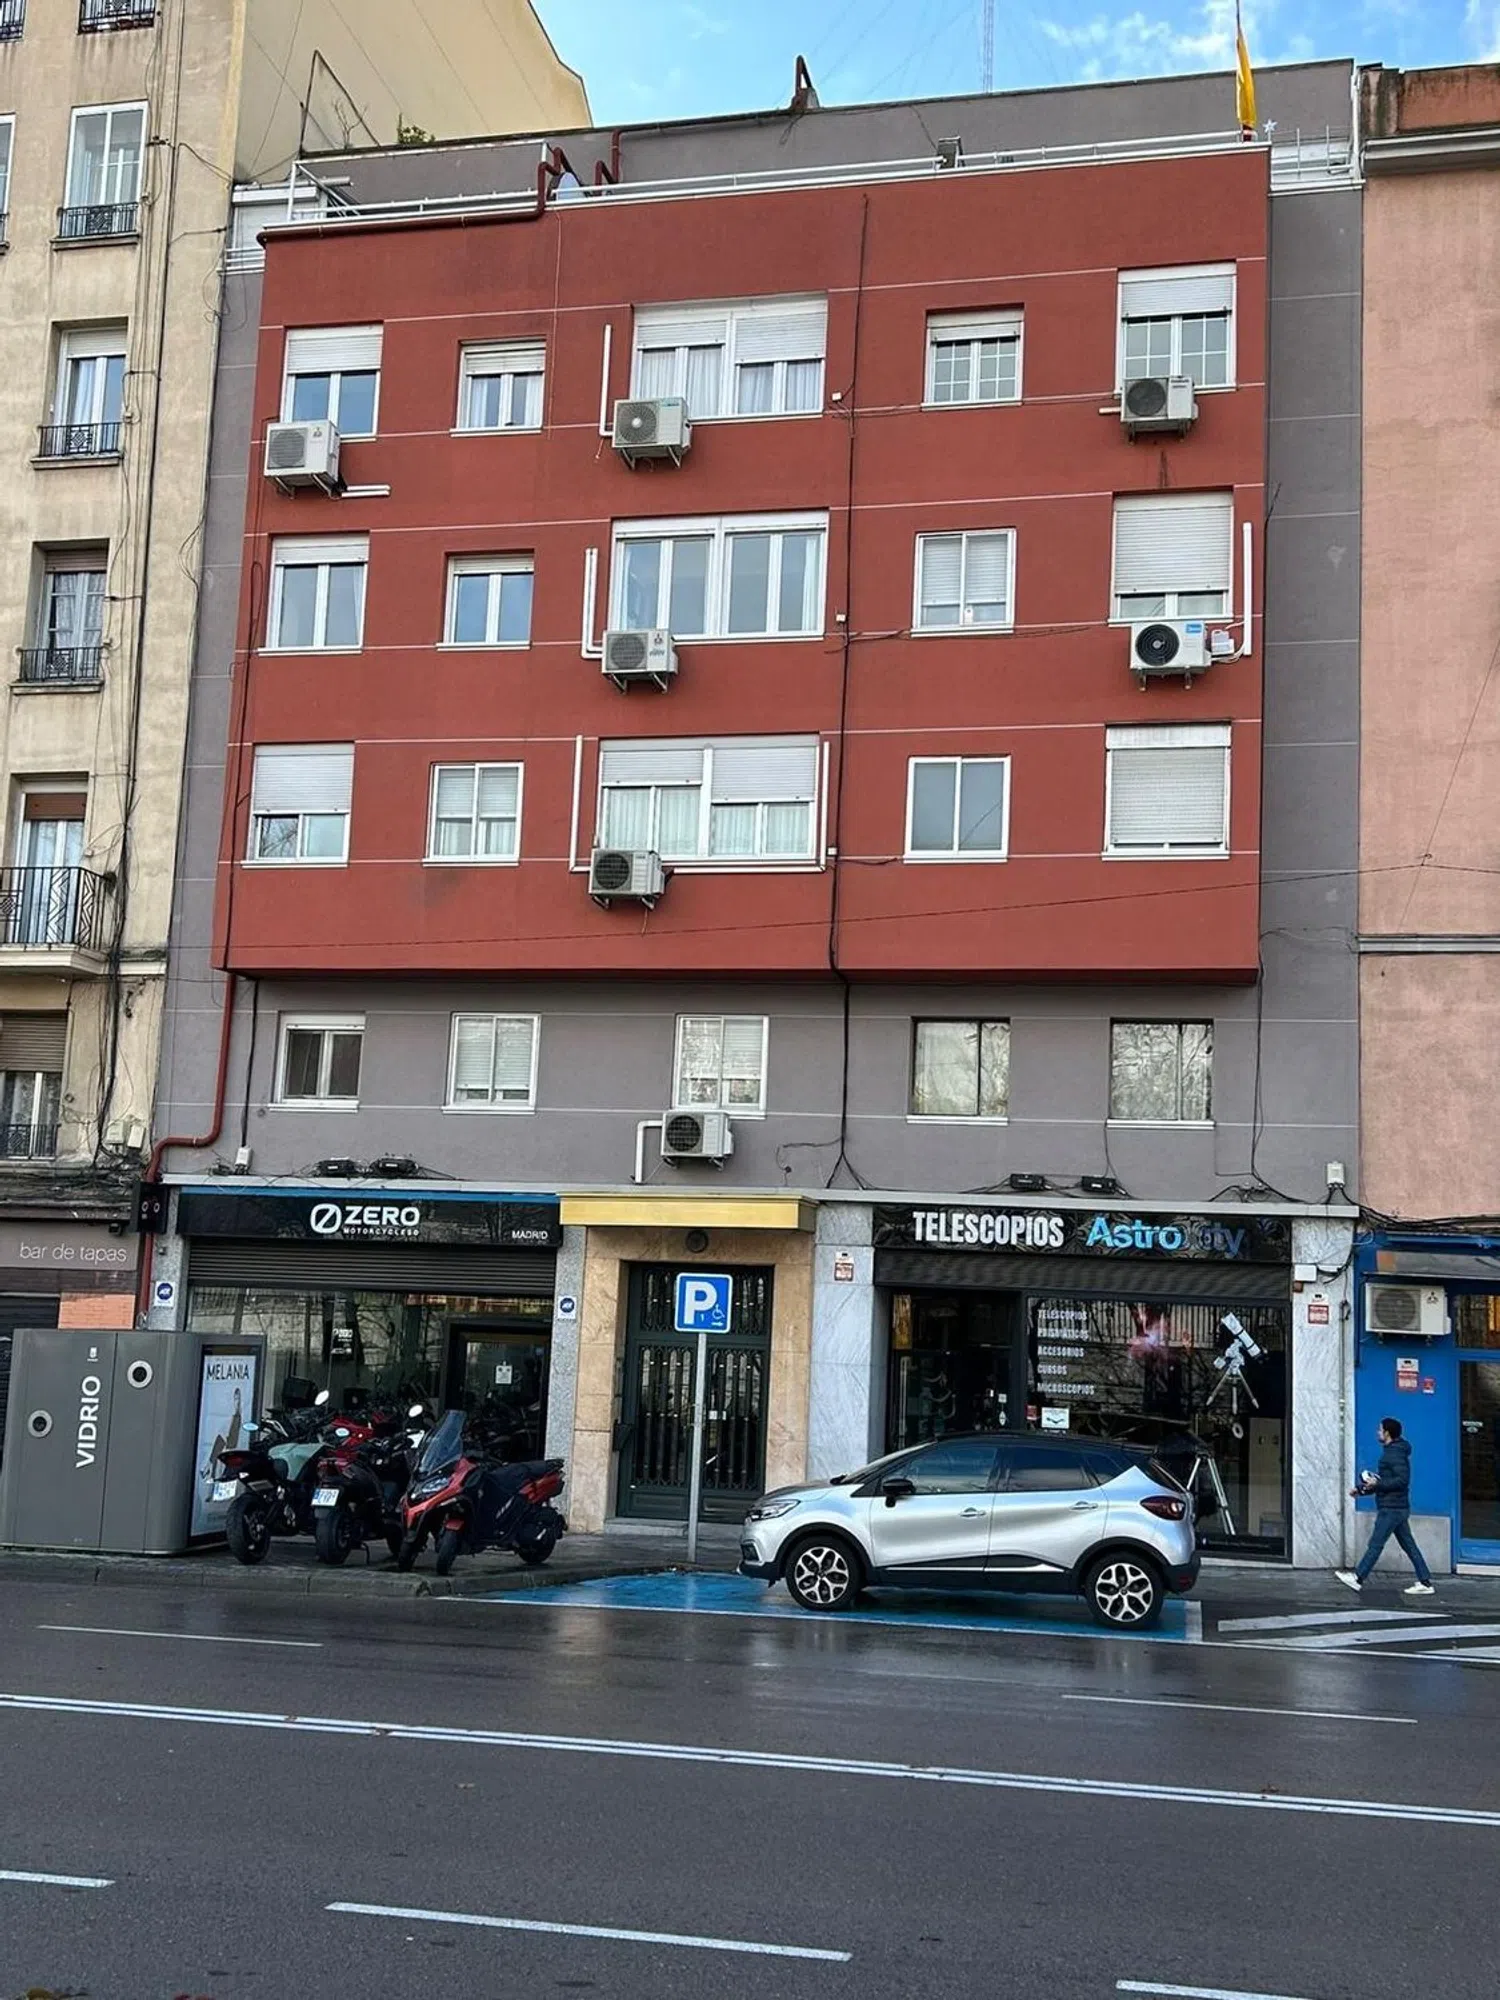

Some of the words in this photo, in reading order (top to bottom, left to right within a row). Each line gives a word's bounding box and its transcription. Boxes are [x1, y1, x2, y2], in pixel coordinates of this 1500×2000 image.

[344, 1205, 420, 1226] ZERO
[511, 1230, 548, 1240] MADRID
[913, 1210, 1064, 1248] TELESCOPIOS
[19, 1242, 47, 1259] bar
[52, 1243, 74, 1260] de
[80, 1245, 127, 1265] tapas
[683, 1281, 717, 1325] P
[1037, 1309, 1087, 1320] TELESCOPIOS
[1037, 1345, 1084, 1357] ACCESORIOS
[206, 1364, 250, 1381] MELANIA
[1037, 1364, 1067, 1375] CURSOS
[1037, 1382, 1095, 1396] MICROSCOPIOS
[76, 1376, 101, 1468] VIDRIO
